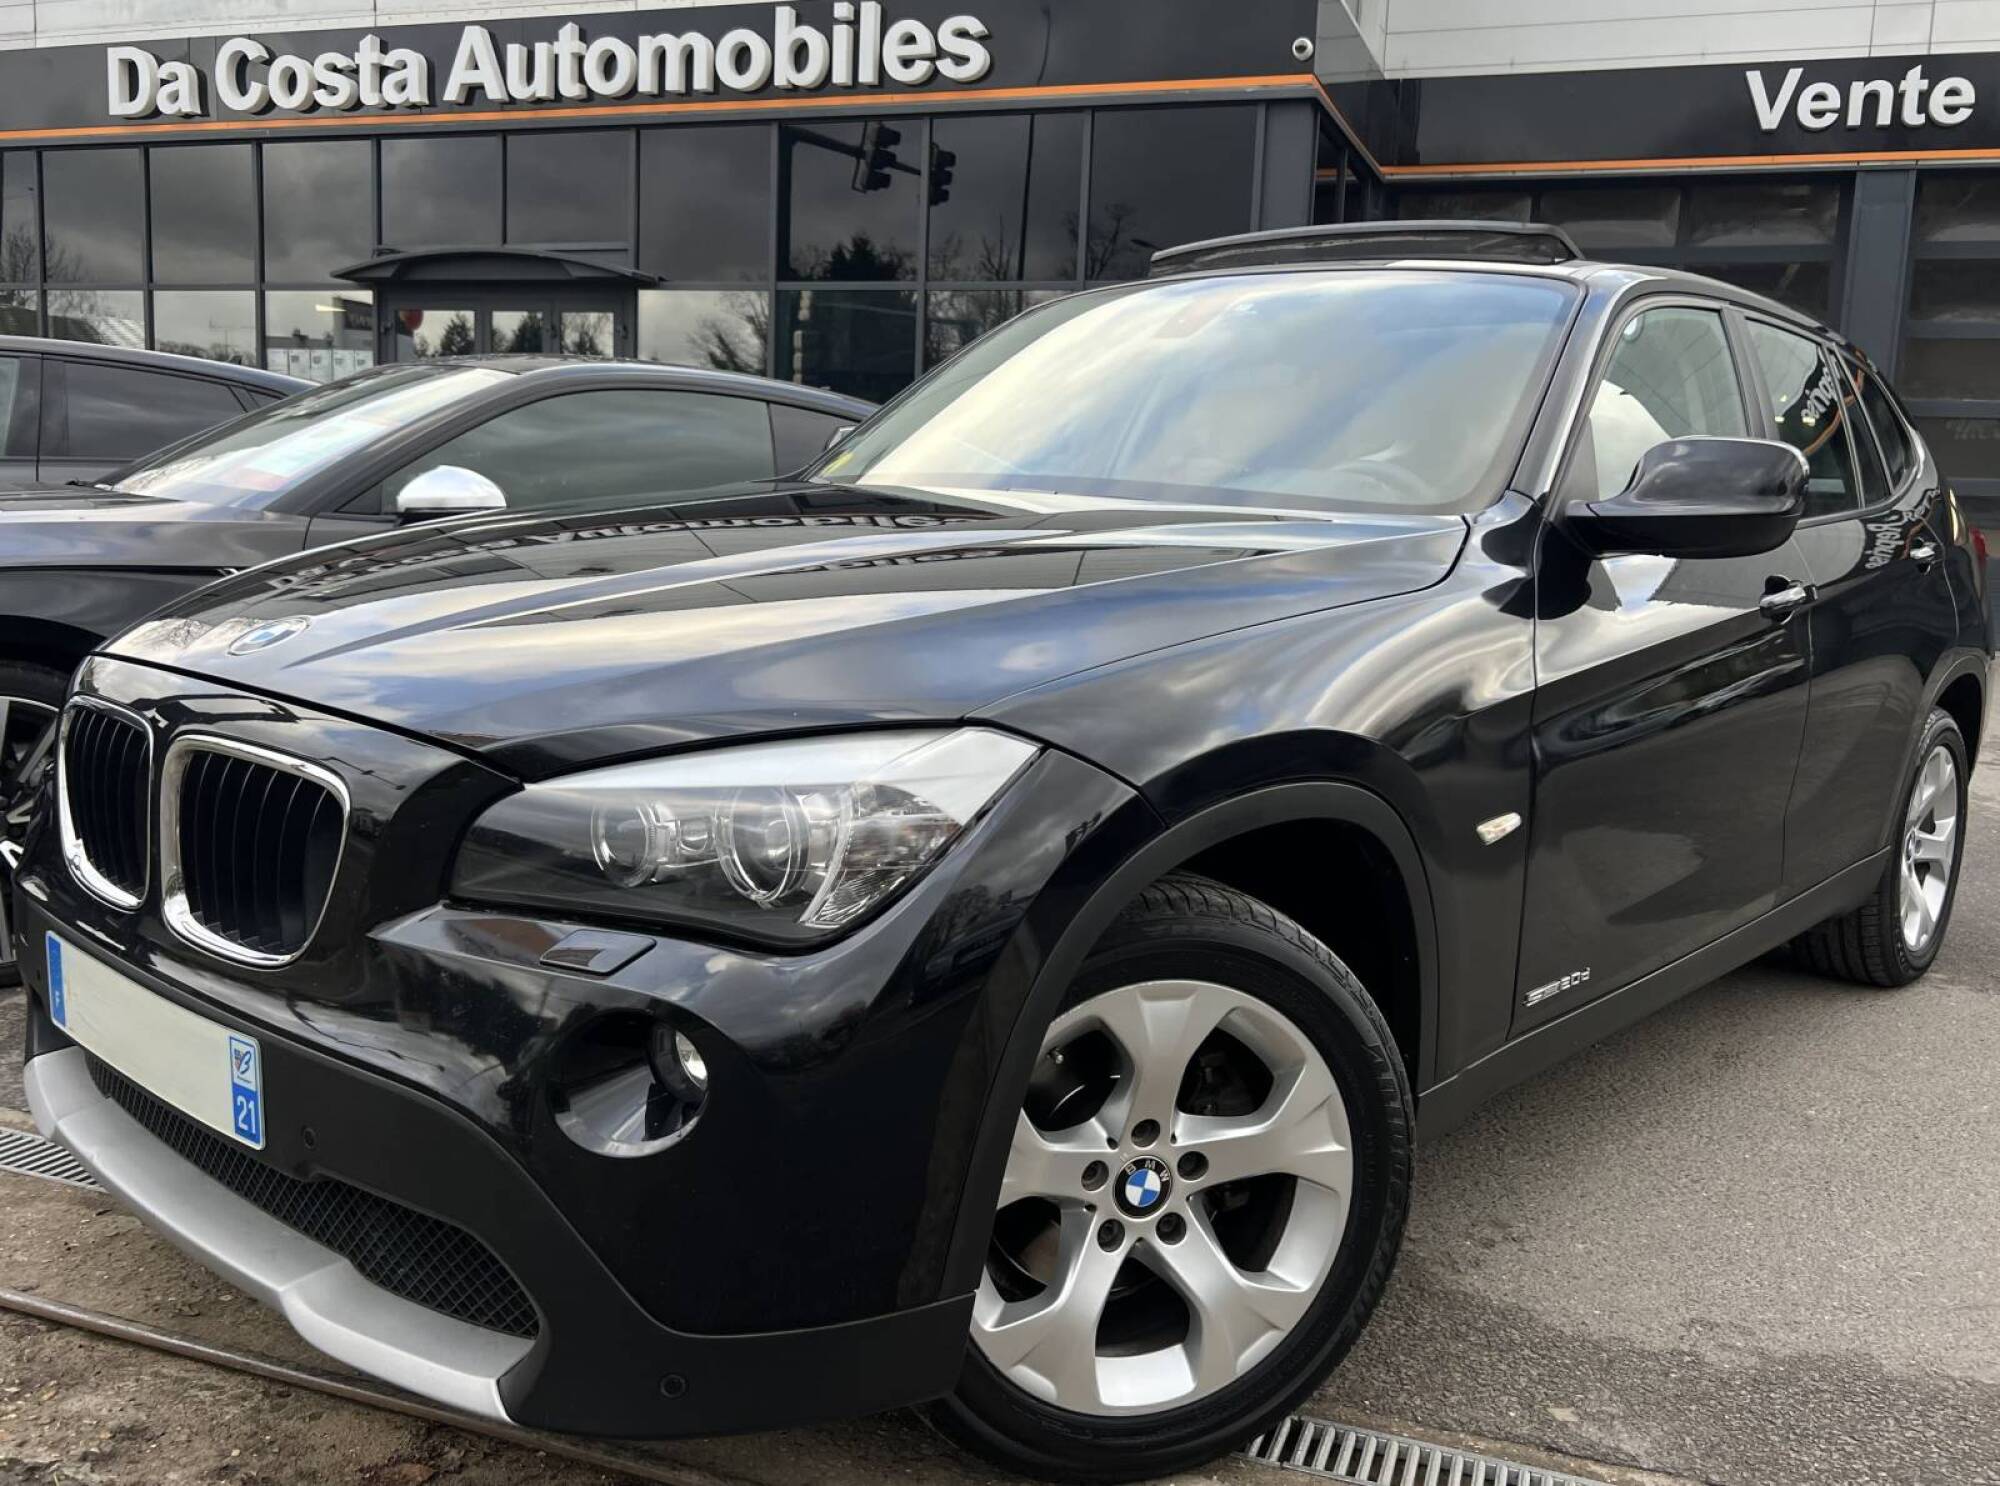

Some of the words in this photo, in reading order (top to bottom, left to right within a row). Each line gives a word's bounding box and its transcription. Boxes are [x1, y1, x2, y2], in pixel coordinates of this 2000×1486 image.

[107, 46, 201, 116] Da
[215, 34, 429, 111] Costa
[443, 1, 991, 101] Automobiles
[1746, 65, 1976, 130] Vente
[236, 1095, 256, 1134] 21
[1124, 1160, 1170, 1182] BMW
